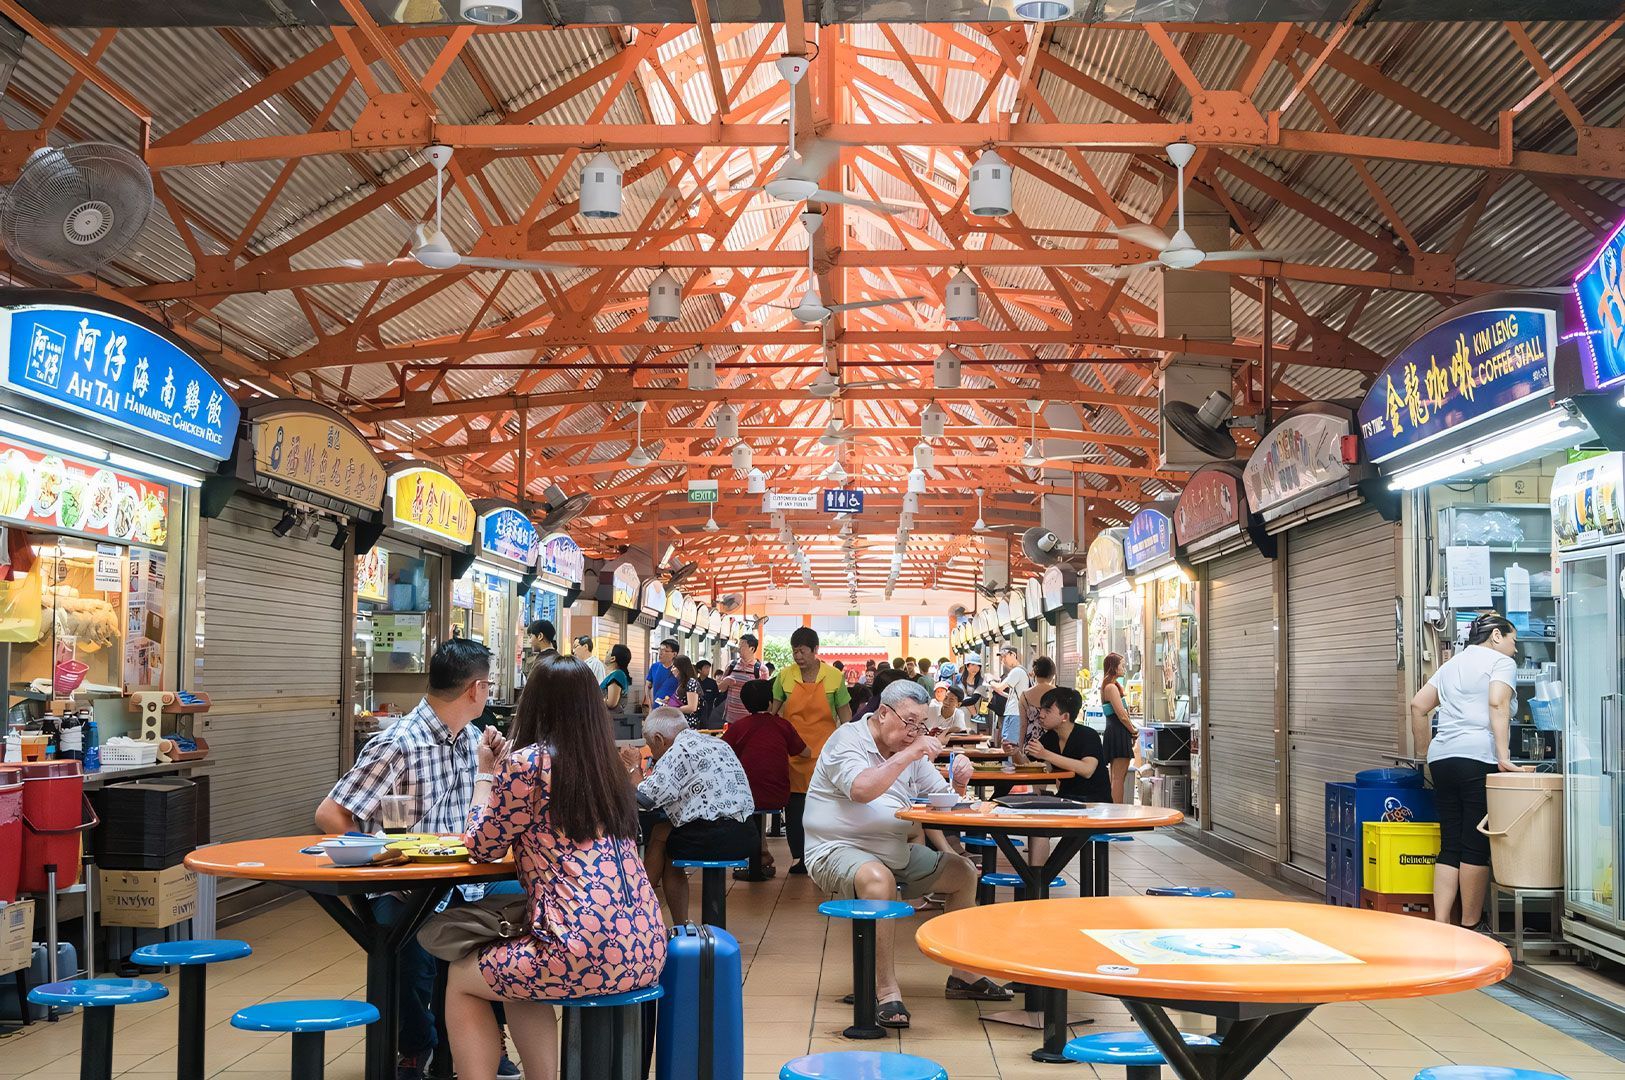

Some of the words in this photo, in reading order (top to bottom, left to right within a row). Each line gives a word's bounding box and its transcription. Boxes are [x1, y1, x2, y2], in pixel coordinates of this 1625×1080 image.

[1472, 327, 1492, 356] KIM
[1491, 313, 1519, 347] LENG
[1478, 349, 1515, 386] COFFEE
[1514, 335, 1545, 369] STALL
[66, 371, 93, 402] AH
[95, 379, 120, 412] TAI
[124, 391, 173, 426] HAINANESE
[172, 412, 206, 439] CHICKEN
[205, 427, 223, 445] RICE
[695, 491, 711, 501] EXIT
[117, 894, 155, 908] DASANI
